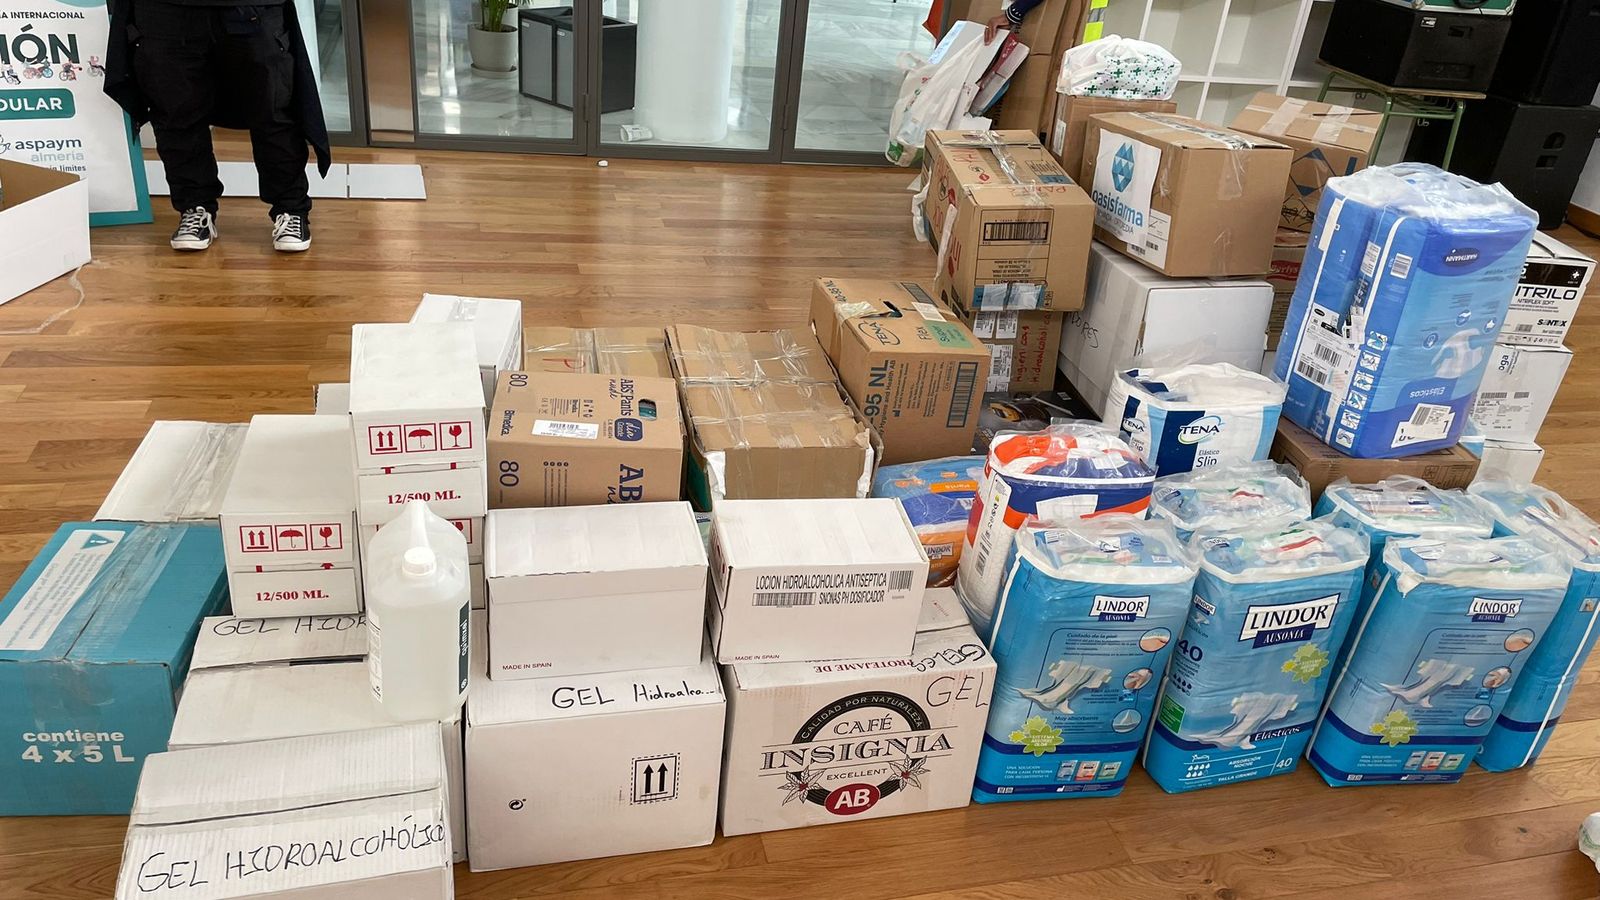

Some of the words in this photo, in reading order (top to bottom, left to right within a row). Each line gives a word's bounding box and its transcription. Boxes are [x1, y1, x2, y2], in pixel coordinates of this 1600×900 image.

[10, 11, 85, 19] INTERNACIONAL
[15, 138, 82, 151] aspaym
[1092, 190, 1143, 228] oasisfarma
[509, 373, 528, 388] 80
[868, 359, 889, 387] NL
[620, 396, 634, 416] Pants
[1124, 418, 1145, 433] TENA
[1181, 425, 1220, 435] TENA
[499, 460, 519, 487] 80
[435, 489, 462, 501] ML.
[755, 575, 781, 590] LOCION
[782, 574, 844, 589] HIDROALCOHOLICA
[845, 572, 887, 588] ANTISEPTICA
[256, 590, 299, 602] 12/500
[303, 589, 329, 600] ML.
[850, 589, 885, 604] DOSIFICADOR
[1096, 600, 1144, 612] LINDOR
[1473, 602, 1516, 614] LINDOR
[1250, 604, 1329, 630] LINDOR
[213, 618, 279, 636] GEL
[1263, 628, 1305, 644] AUSONIA
[1178, 639, 1203, 662] 40
[814, 665, 832, 674] DE
[551, 686, 615, 709] GEL
[926, 671, 989, 708] GEL
[800, 705, 841, 739] CALIDAD
[845, 697, 867, 708] POR
[871, 696, 924, 728] NATURALEZA
[833, 714, 894, 736] CAFÉ
[22, 730, 125, 743] contiene
[1254, 727, 1300, 742] Elásticos
[22, 745, 43, 763] 4
[54, 749, 75, 763] x
[83, 745, 104, 763] 5
[113, 745, 135, 763] L
[760, 733, 954, 770] INSIGNIA
[1276, 757, 1293, 769] 40
[826, 768, 888, 781] EXCELLENT
[834, 789, 871, 810] AB
[137, 852, 209, 893] GEL
